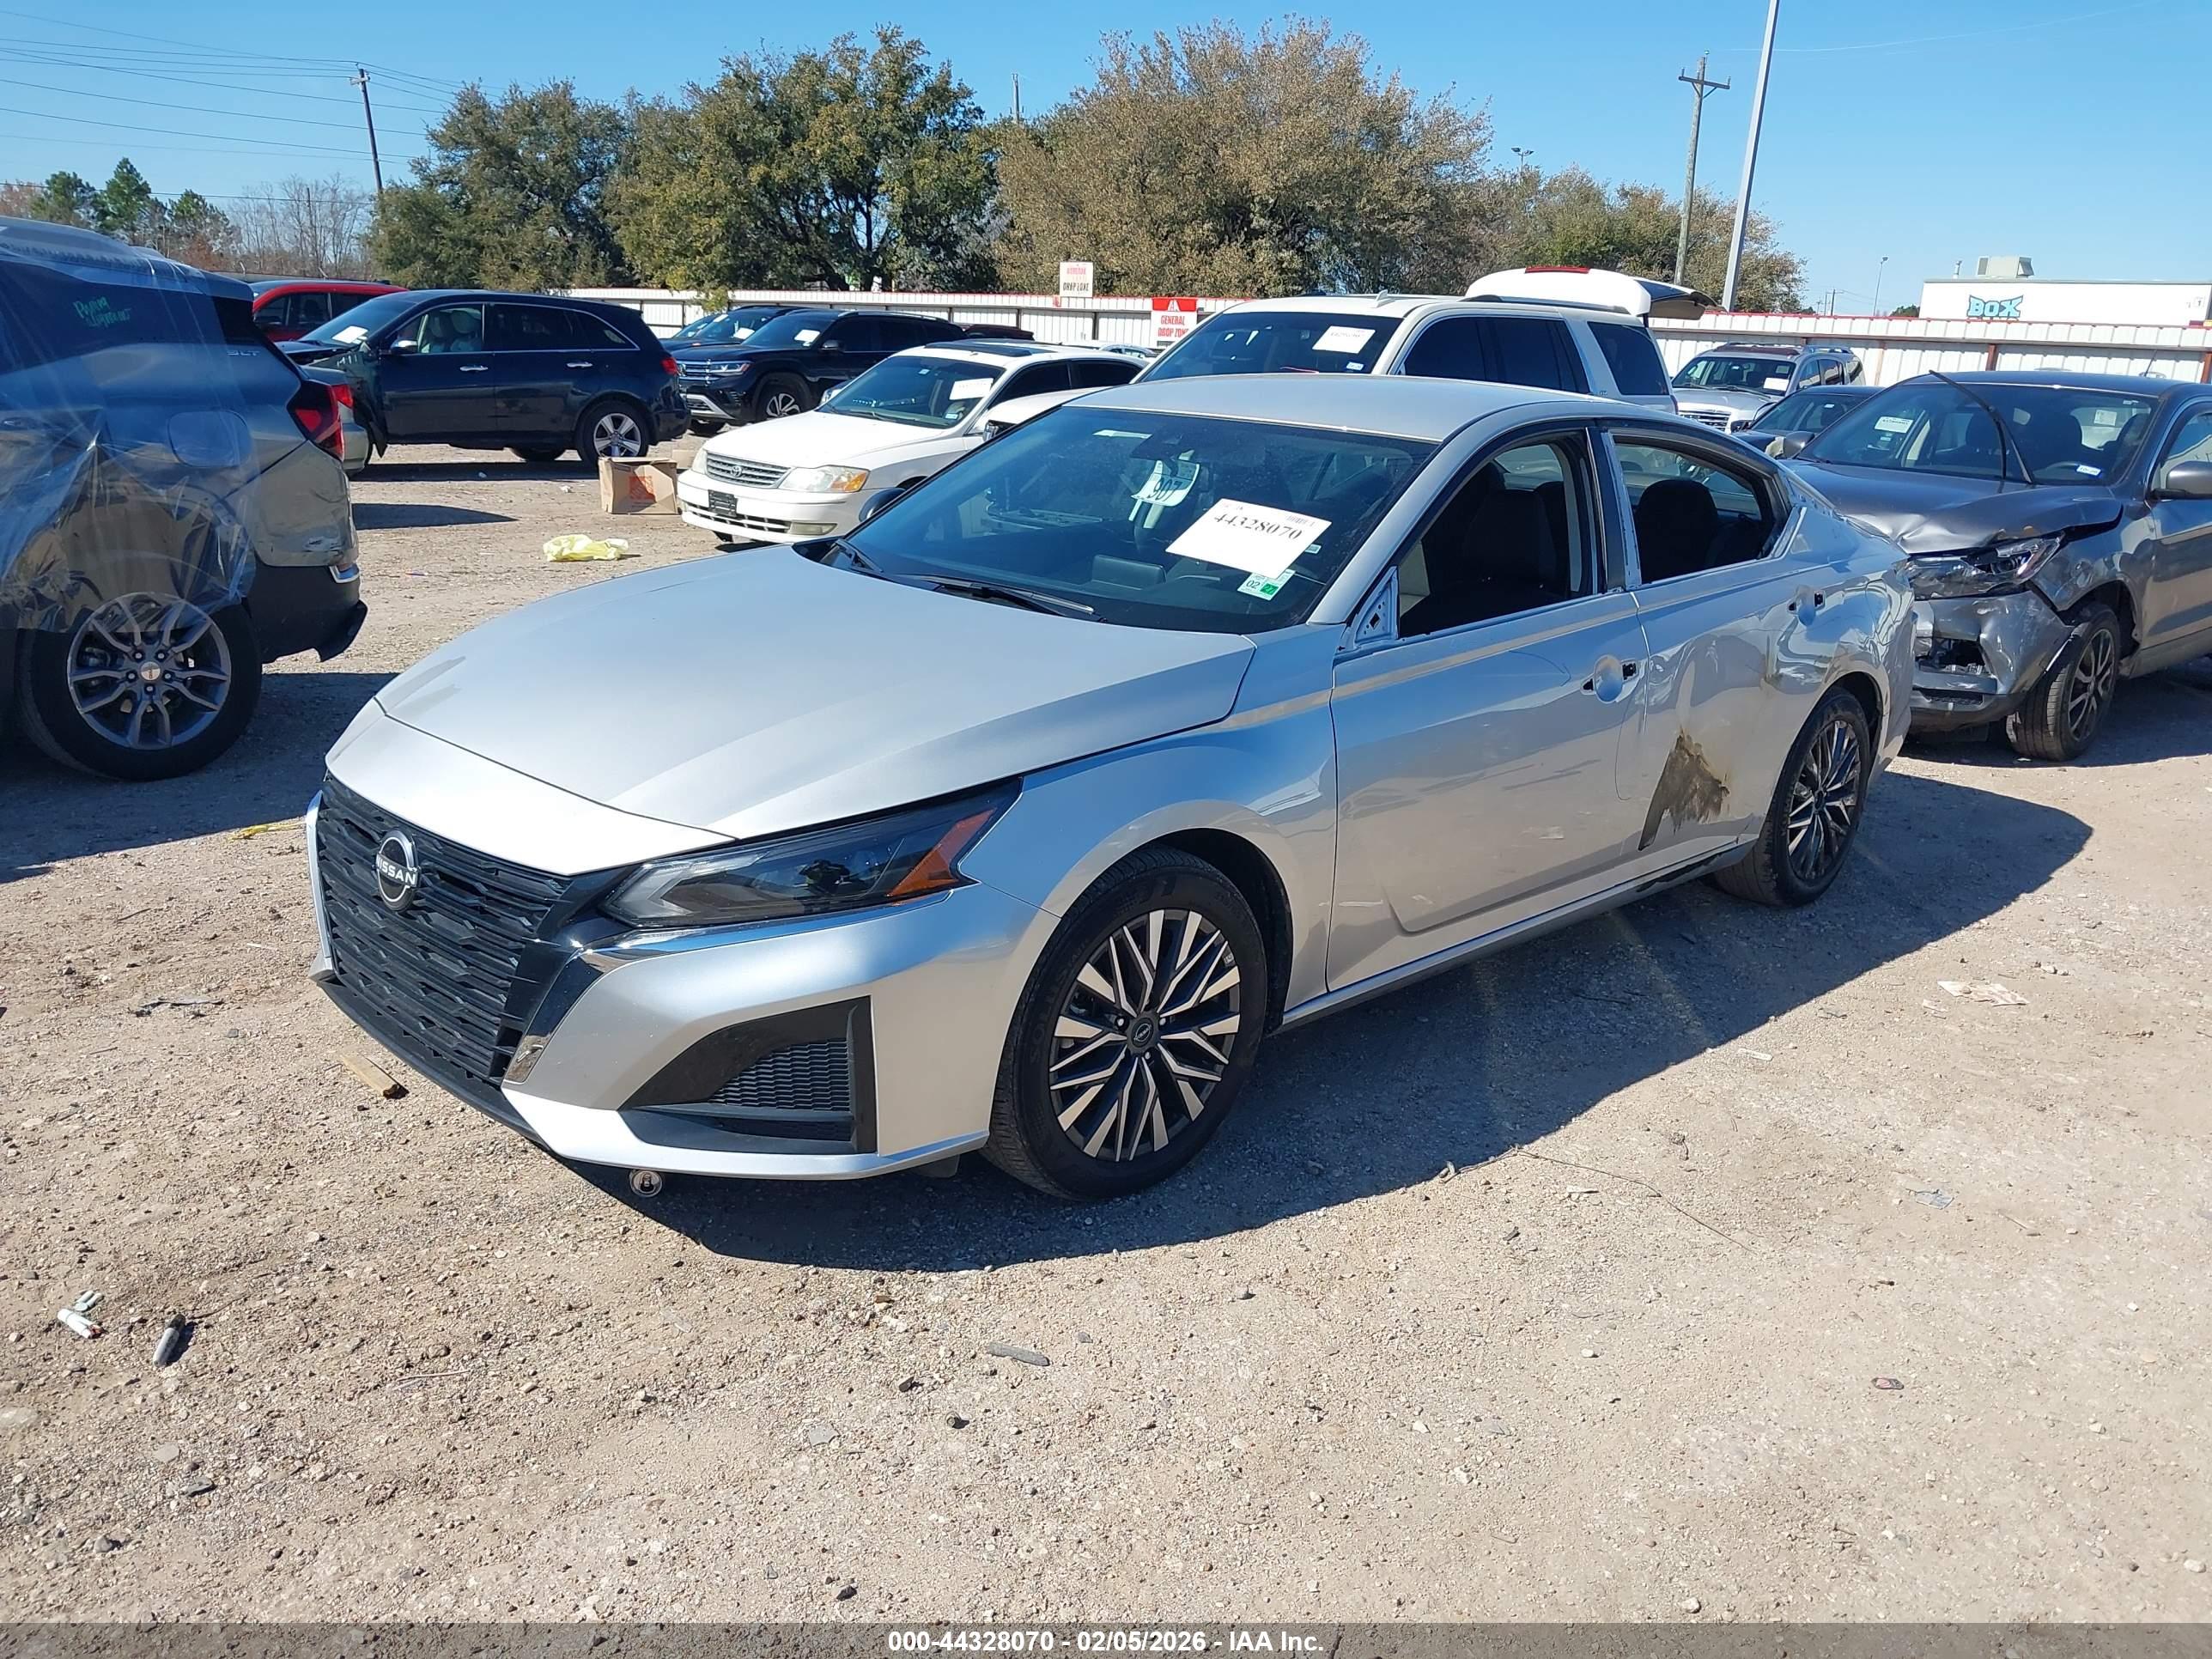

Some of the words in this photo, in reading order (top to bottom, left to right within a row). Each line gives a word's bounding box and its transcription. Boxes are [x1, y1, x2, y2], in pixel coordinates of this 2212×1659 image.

[1967, 295, 2024, 318] BOX
[1160, 315, 1186, 325] GENERAL
[1158, 327, 1174, 337] DROP
[1147, 477, 1183, 502] 907
[1213, 513, 1303, 540] 44328070
[1246, 580, 1261, 590] 02
[376, 854, 416, 885] NISSAN
